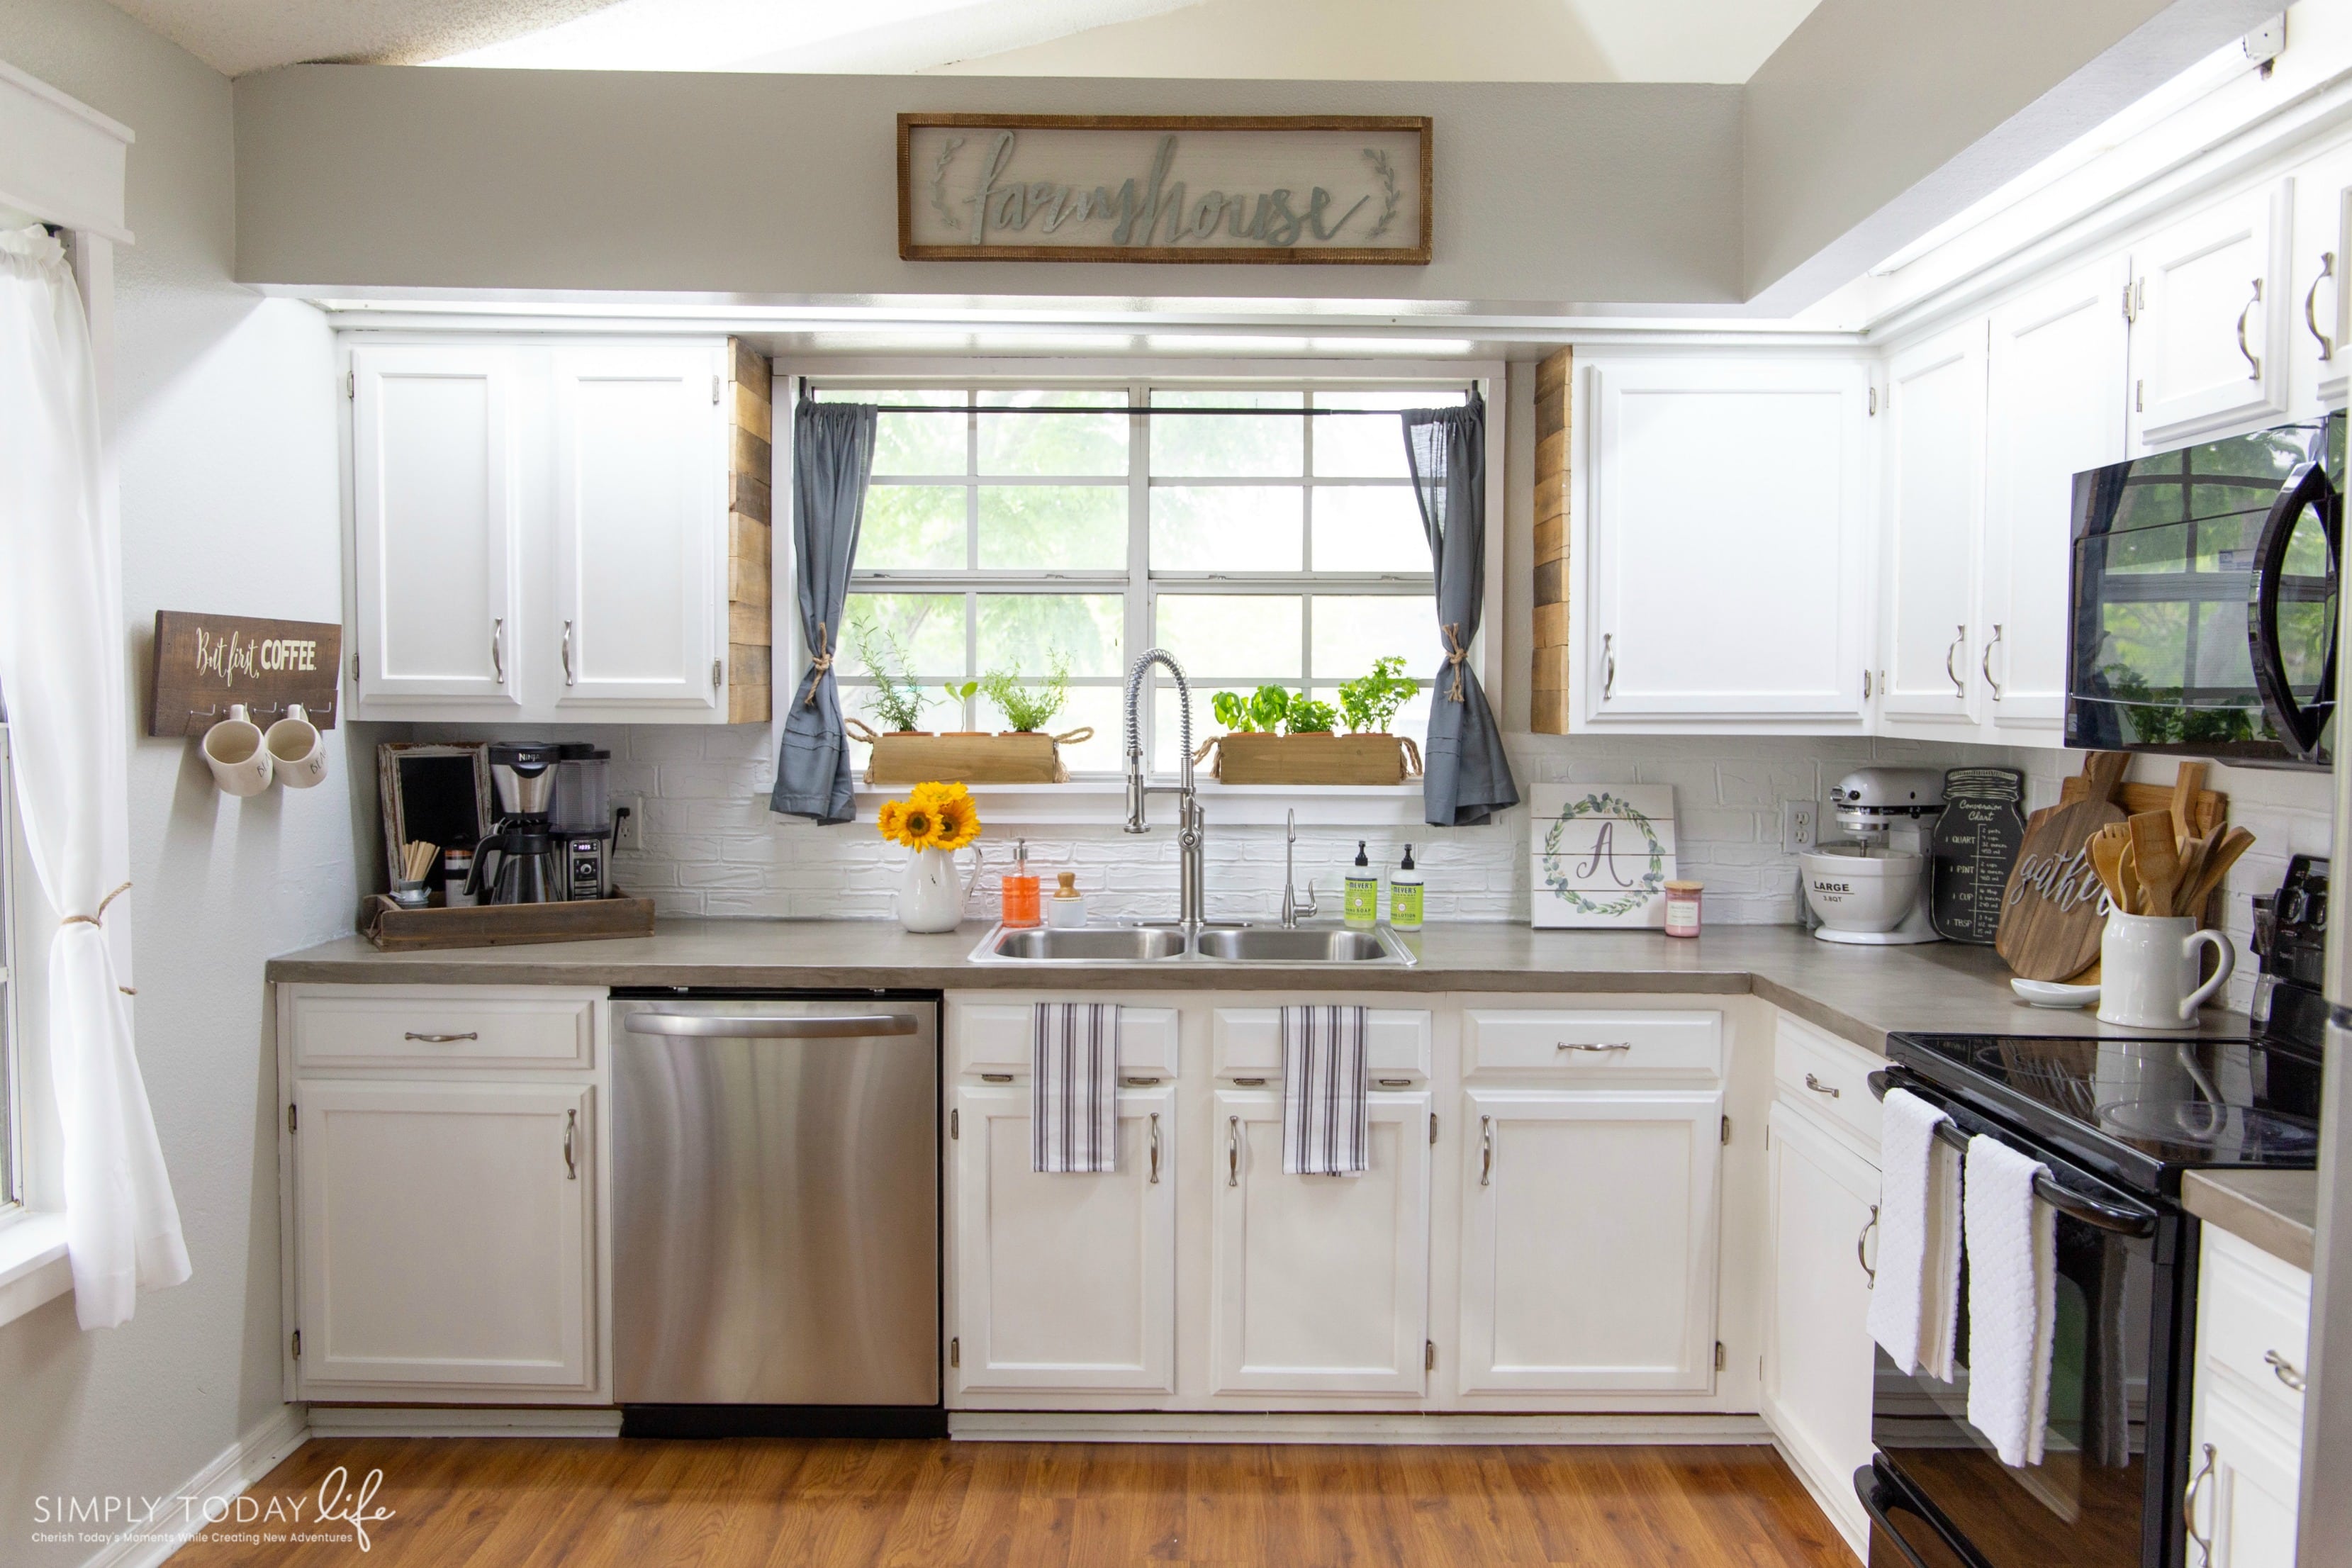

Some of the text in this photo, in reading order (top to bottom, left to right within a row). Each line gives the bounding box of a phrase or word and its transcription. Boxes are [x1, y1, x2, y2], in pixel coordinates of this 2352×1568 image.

[963, 130, 1370, 246] farmhouse
[196, 627, 228, 678] But
[1959, 799, 2003, 810] Conversion
[1968, 810, 1995, 822] Chart
[1951, 835, 1976, 844] QUART
[1576, 821, 1633, 887] A
[1956, 865, 1975, 874] PINT
[1814, 880, 1850, 892] LARGE
[1959, 892, 1974, 902] CUP
[1953, 918, 1973, 928] TBSP
